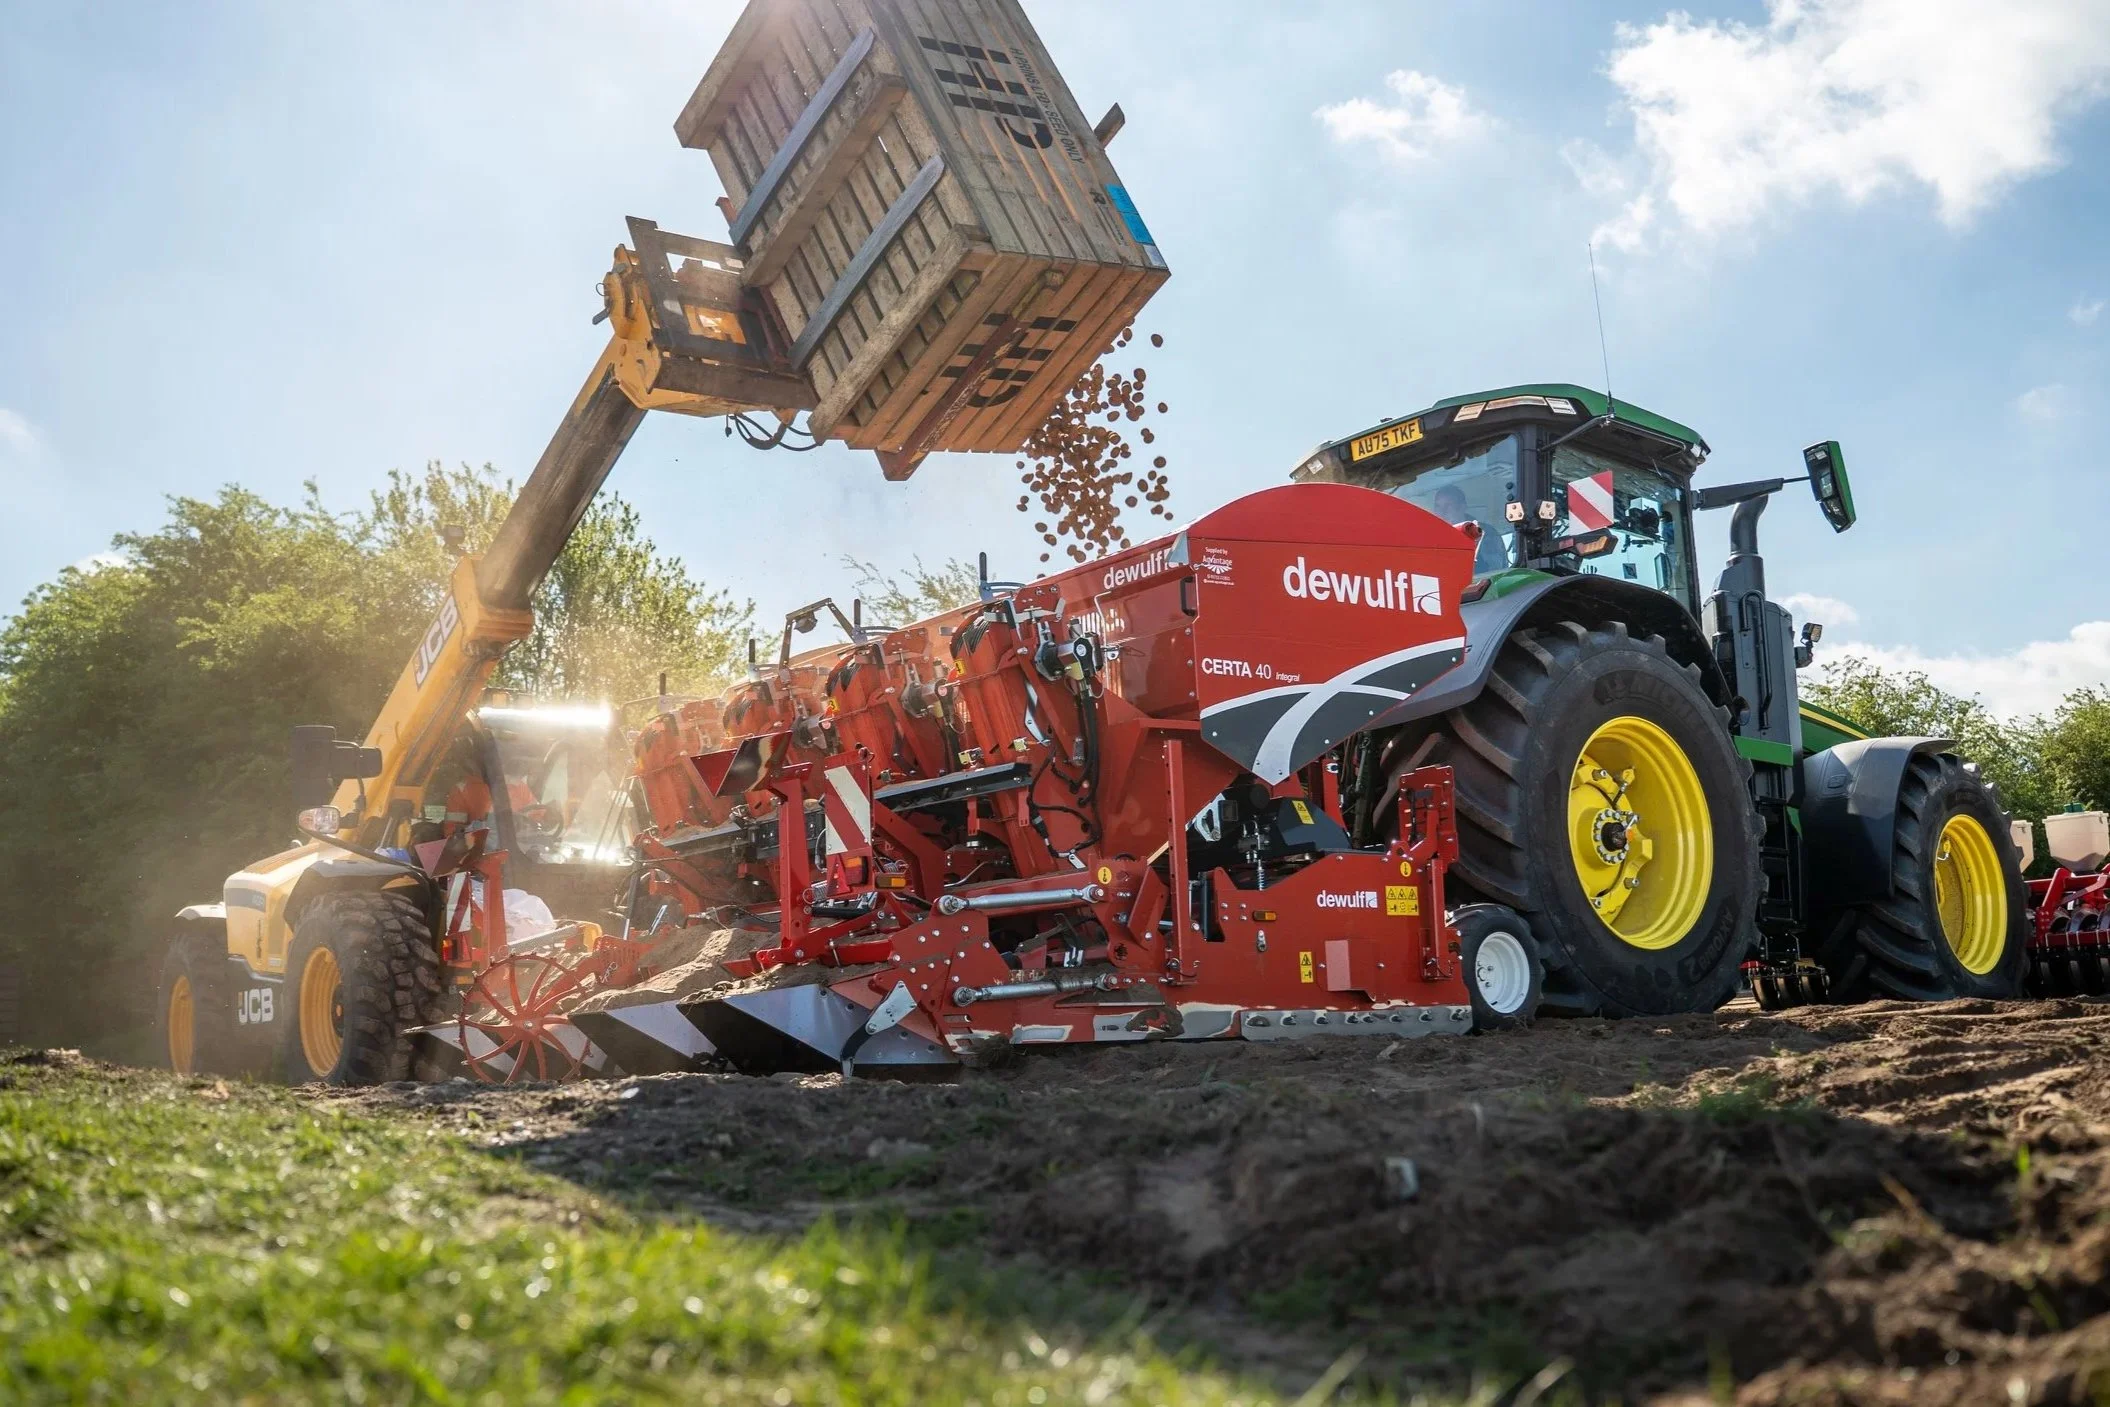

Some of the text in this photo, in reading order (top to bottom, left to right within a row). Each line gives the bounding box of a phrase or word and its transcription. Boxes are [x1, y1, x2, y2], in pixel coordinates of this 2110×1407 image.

[1046, 110, 1069, 136] SEED
[1062, 138, 1085, 164] ONLY
[1358, 422, 1416, 457] AU75 TKF
[1103, 550, 1163, 590] dewulf
[1283, 556, 1408, 611] dewulf
[415, 594, 458, 685] JCB
[1201, 657, 1253, 680] CERTA
[1255, 663, 1272, 680] 40
[1316, 889, 1366, 908] dewulf
[238, 987, 274, 1024] JCB
